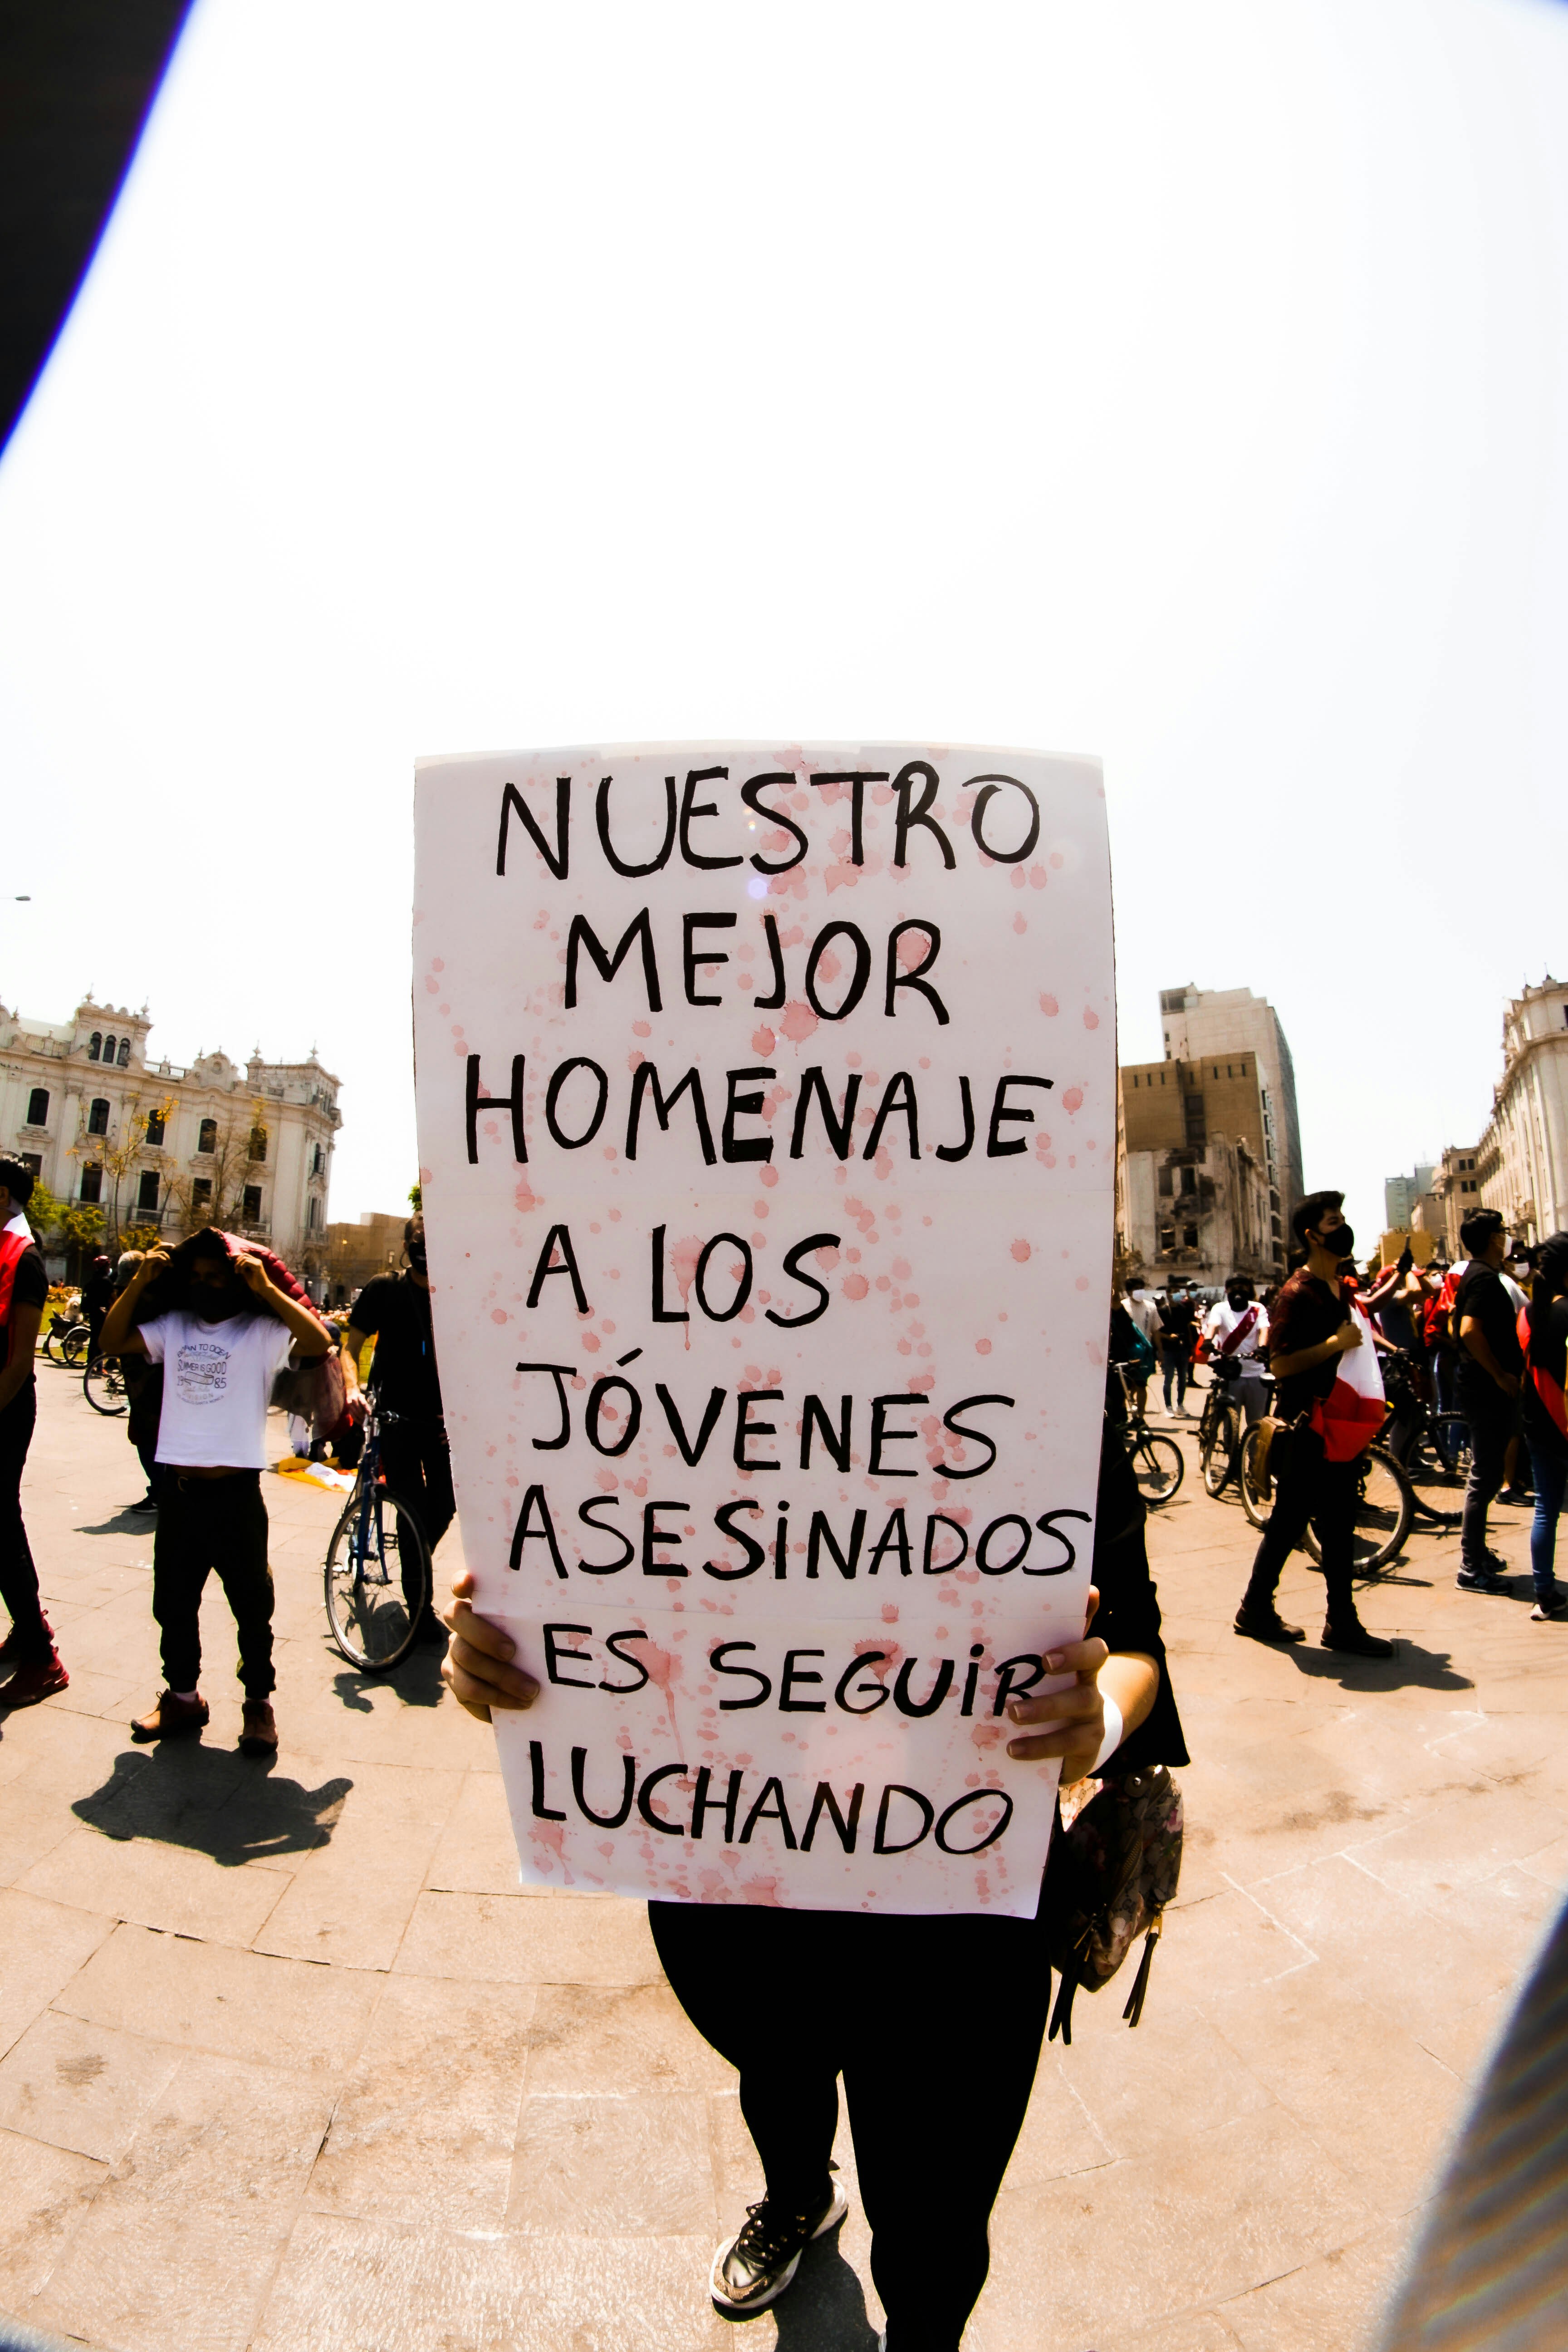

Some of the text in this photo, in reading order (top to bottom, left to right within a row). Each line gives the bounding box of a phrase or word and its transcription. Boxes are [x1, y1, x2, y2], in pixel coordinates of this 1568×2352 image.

[496, 760, 1040, 880] NUESTRO
[564, 906, 950, 1025] MEJOR
[466, 1054, 1054, 1166] HOMENAJE
[526, 1224, 841, 1327] A LOS
[206, 1362, 226, 1375] GOOD
[214, 1377, 226, 1389] 85
[515, 1348, 1015, 1480] JÓVENES
[543, 1623, 649, 1694] ES
[529, 1740, 1014, 1855] LUCHANDO
